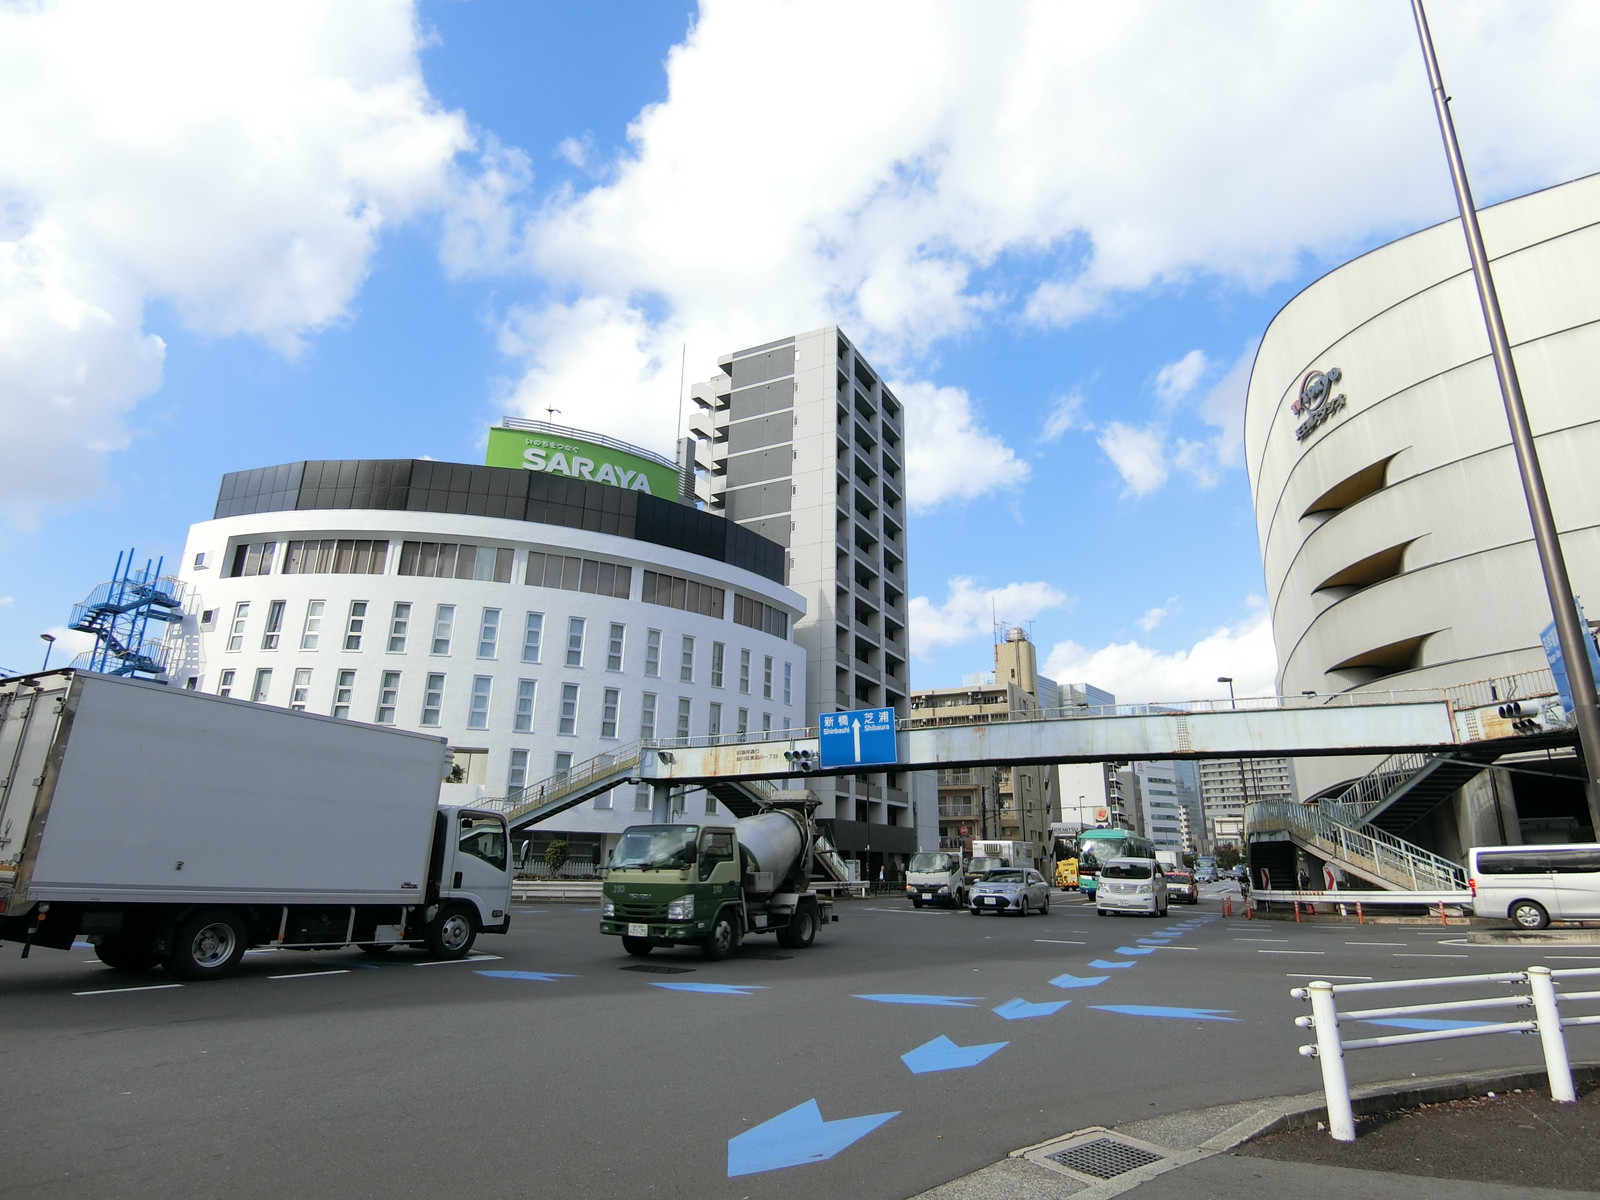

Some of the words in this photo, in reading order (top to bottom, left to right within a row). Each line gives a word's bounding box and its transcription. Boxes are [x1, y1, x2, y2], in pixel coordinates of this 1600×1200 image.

[525, 438, 579, 453] いのちをつなぐ
[522, 447, 652, 495] SARAYA
[824, 714, 849, 727] 新橋
[864, 711, 889, 724] 芝浦
[823, 727, 850, 735] Shinbashi
[864, 724, 890, 732] Shibaura
